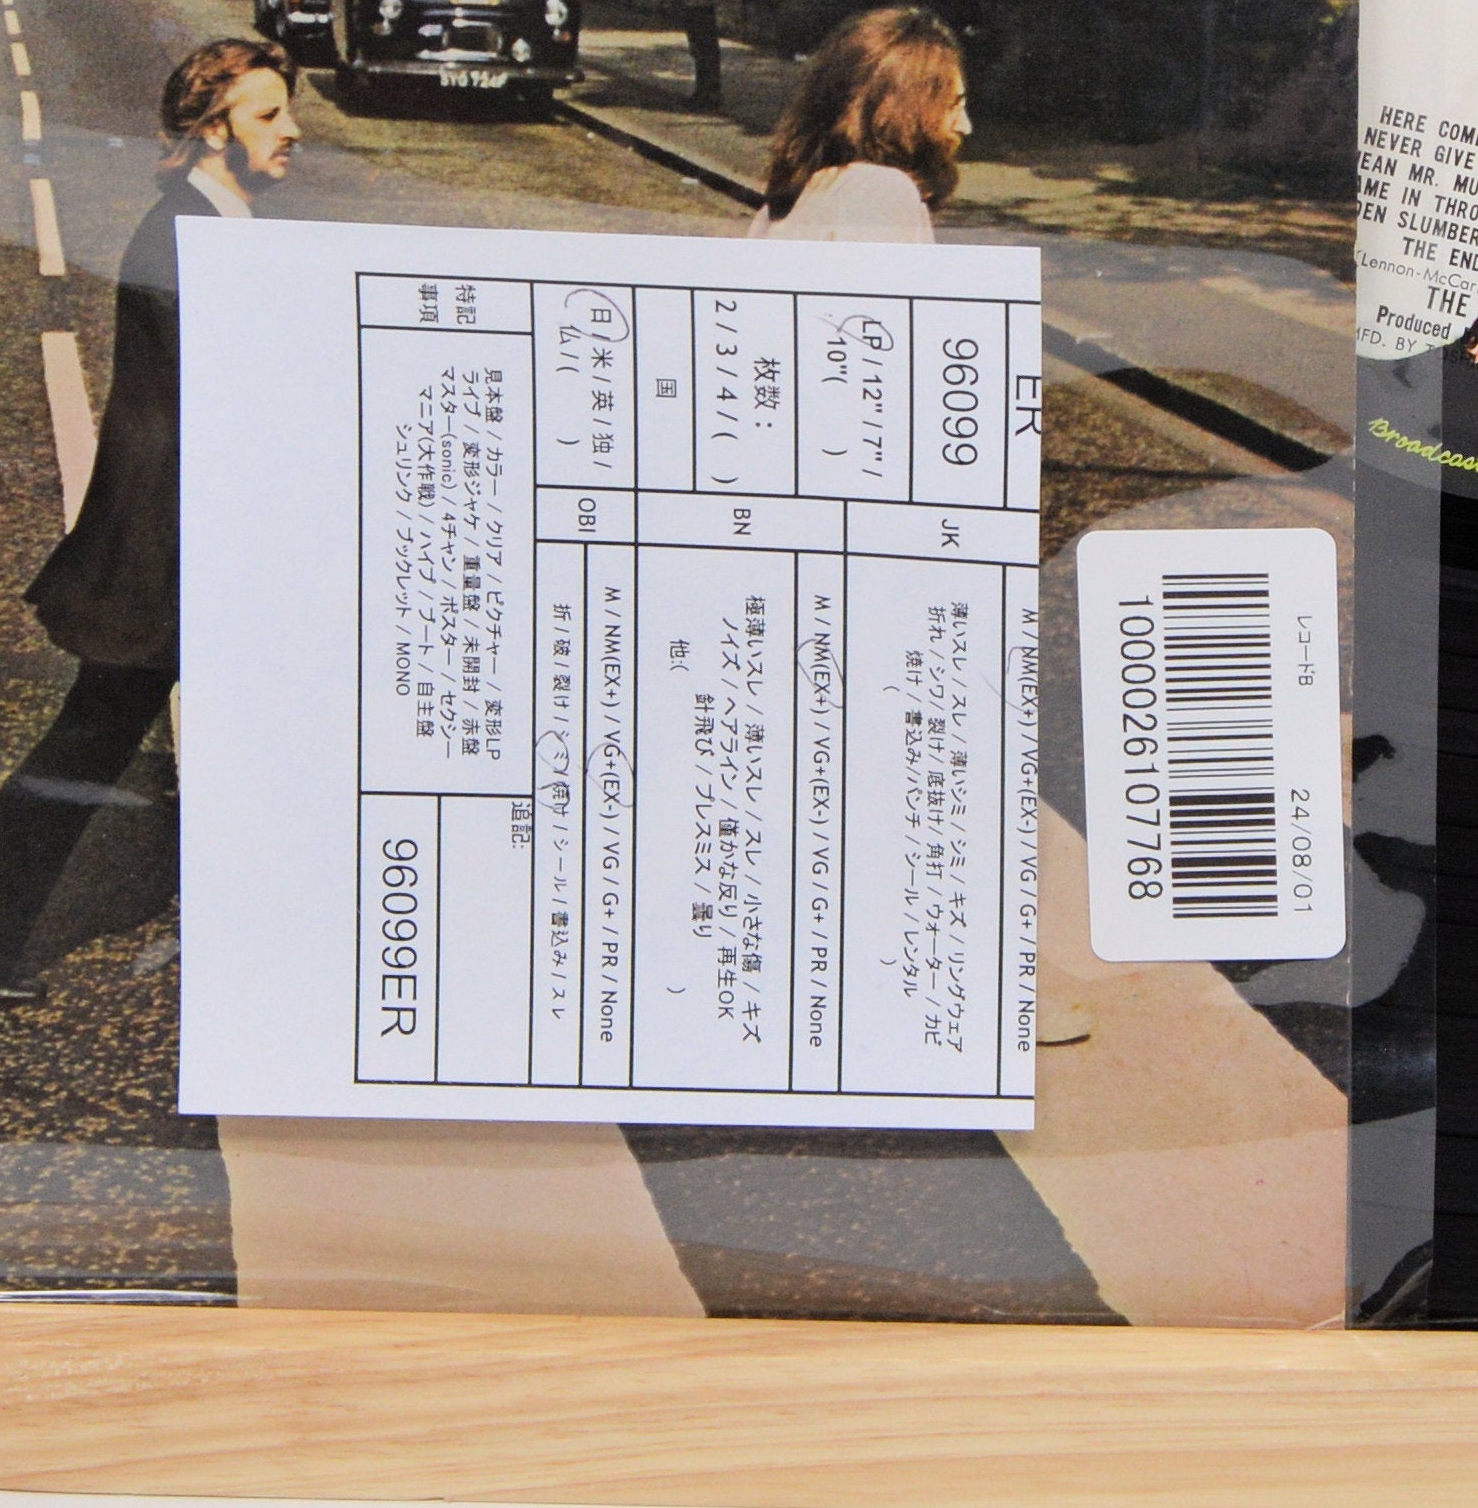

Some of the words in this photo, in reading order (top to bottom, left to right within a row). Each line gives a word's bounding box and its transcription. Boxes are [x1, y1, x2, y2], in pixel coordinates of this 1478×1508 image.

[1379, 105, 1428, 134] HERE
[1363, 126, 1422, 158] NEVER
[1434, 144, 1476, 170] GIVE
[1408, 162, 1439, 188] MR.
[1401, 186, 1422, 208] IN
[1402, 236, 1438, 262] THE
[1427, 285, 1471, 318] THE
[862, 320, 882, 350] LP
[1376, 305, 1452, 347] Produced
[1356, 326, 1386, 347] FD.
[1394, 336, 1425, 362] BY
[655, 378, 677, 399] 国
[941, 338, 979, 466] 96099
[1014, 374, 1040, 436] ER
[577, 497, 597, 533] OBI
[733, 508, 752, 536] BN
[941, 518, 960, 548] JK
[1118, 592, 1165, 900] 1000026107768
[808, 736, 831, 825] VG+(EX-)
[811, 847, 830, 875] VG
[1290, 788, 1313, 912] 24/08/01
[811, 897, 829, 924] G+
[380, 838, 419, 1037] 96099ER
[810, 946, 828, 973] PR
[809, 995, 827, 1048] None
[1017, 1000, 1035, 1052] None
